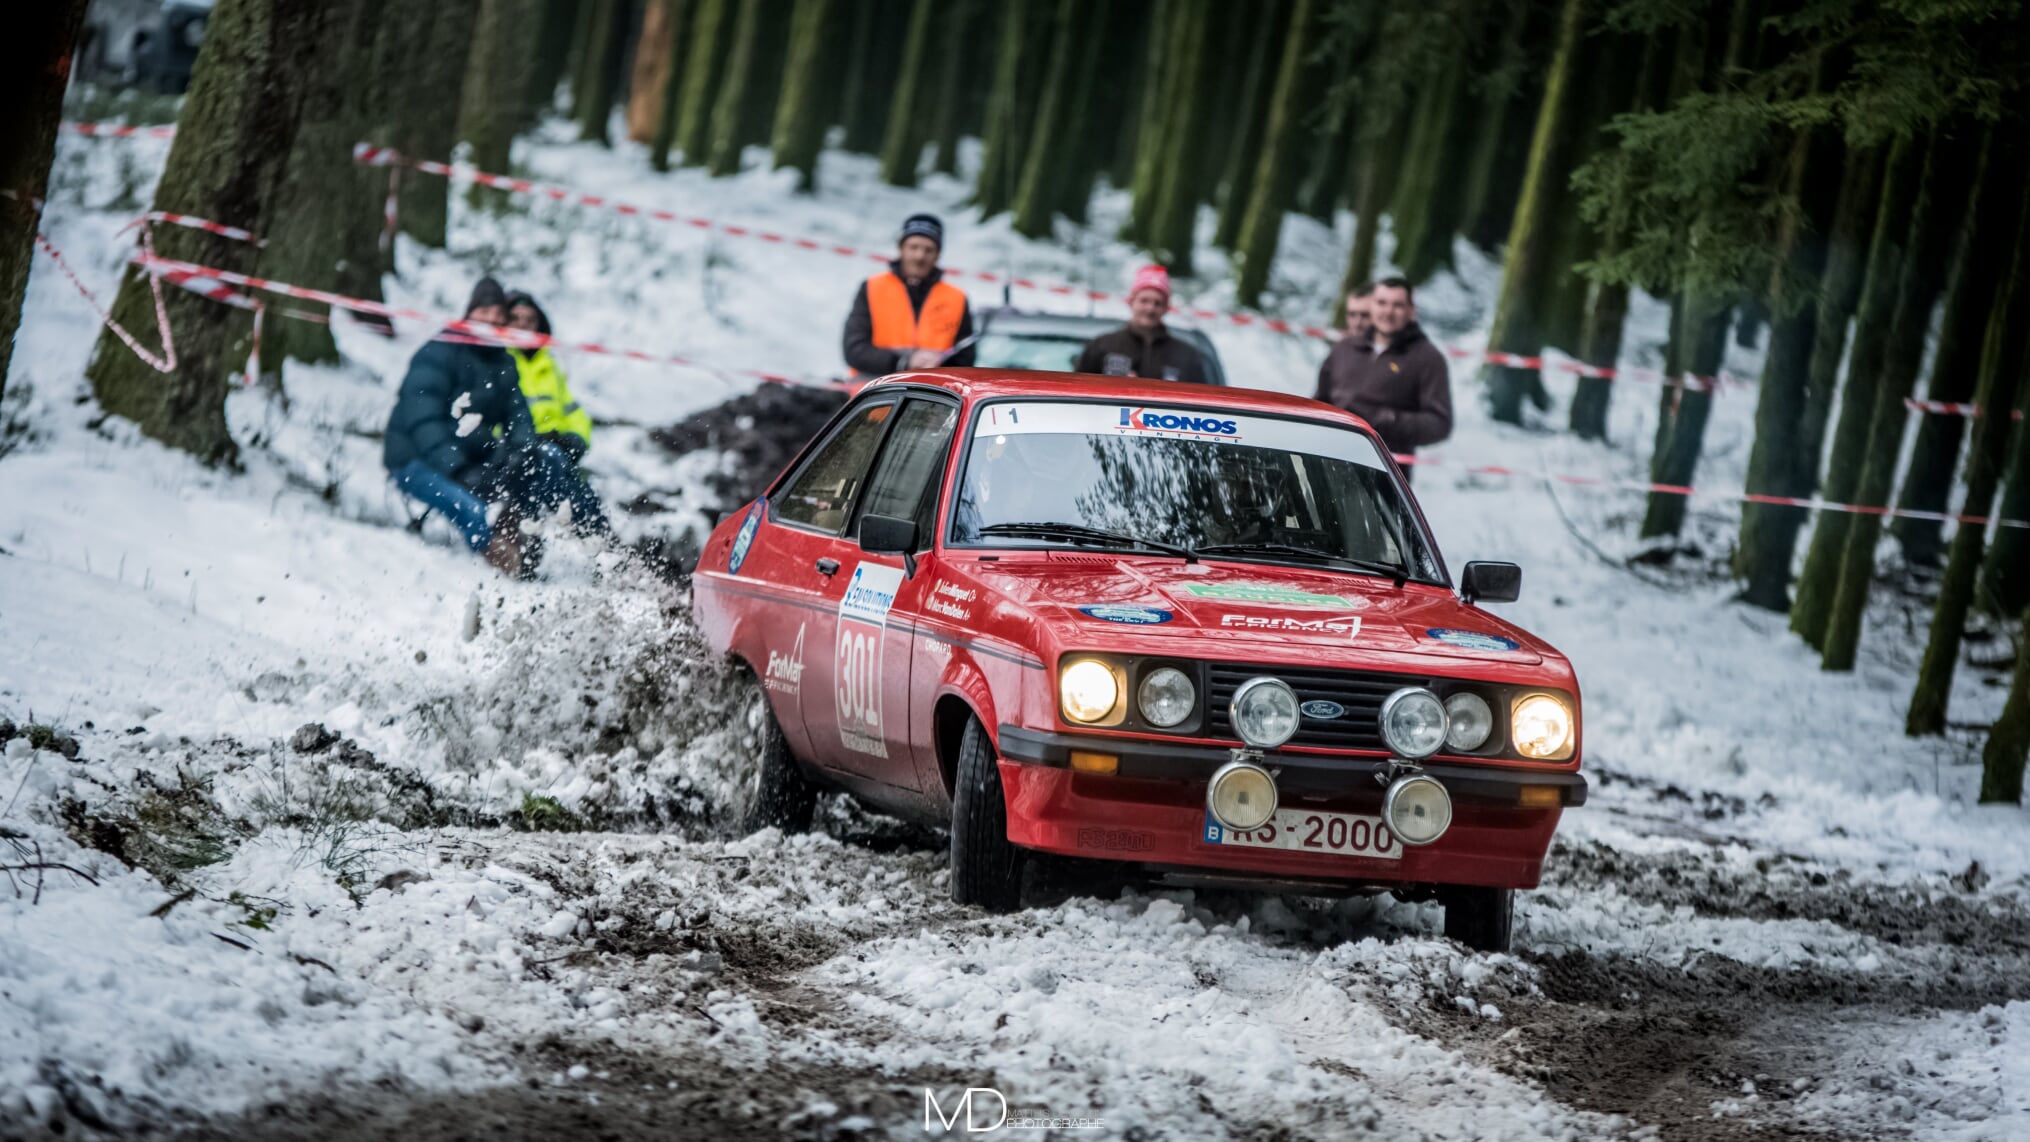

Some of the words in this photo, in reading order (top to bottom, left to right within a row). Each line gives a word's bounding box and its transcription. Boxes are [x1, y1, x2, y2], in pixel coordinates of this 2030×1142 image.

[1120, 407, 1237, 435] KRONOS
[1120, 429, 1240, 444] VINTAGE
[1221, 622, 1347, 634] EFFICIENCY
[840, 630, 878, 726] 301
[1310, 703, 1335, 715] Ford
[1208, 826, 1219, 840] B
